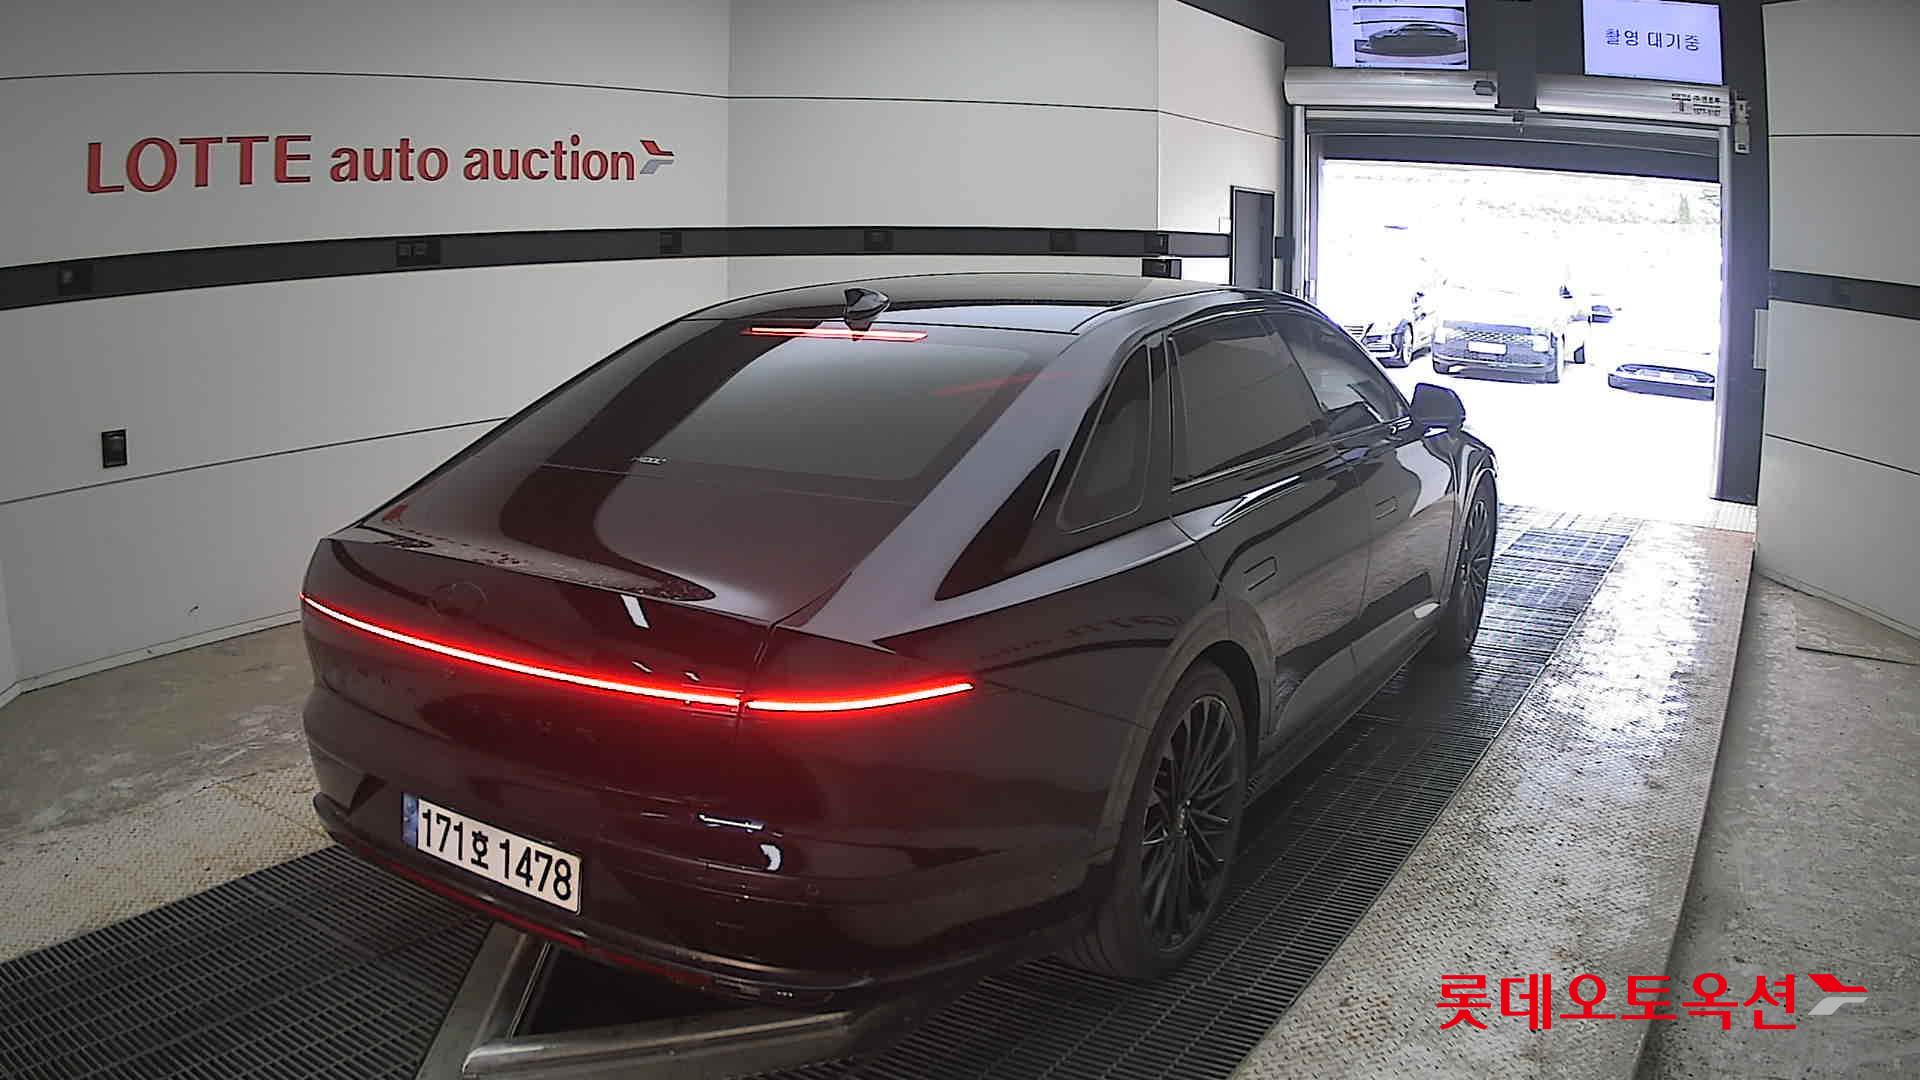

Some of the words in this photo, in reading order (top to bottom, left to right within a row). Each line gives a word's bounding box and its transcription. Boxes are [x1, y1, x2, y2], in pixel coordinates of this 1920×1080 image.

[1647, 31, 1701, 52] 대기중
[87, 135, 312, 193] LOTTE
[329, 138, 449, 182] auto
[463, 133, 636, 182] auction
[422, 808, 489, 870] 171호
[499, 838, 573, 901] 1478
